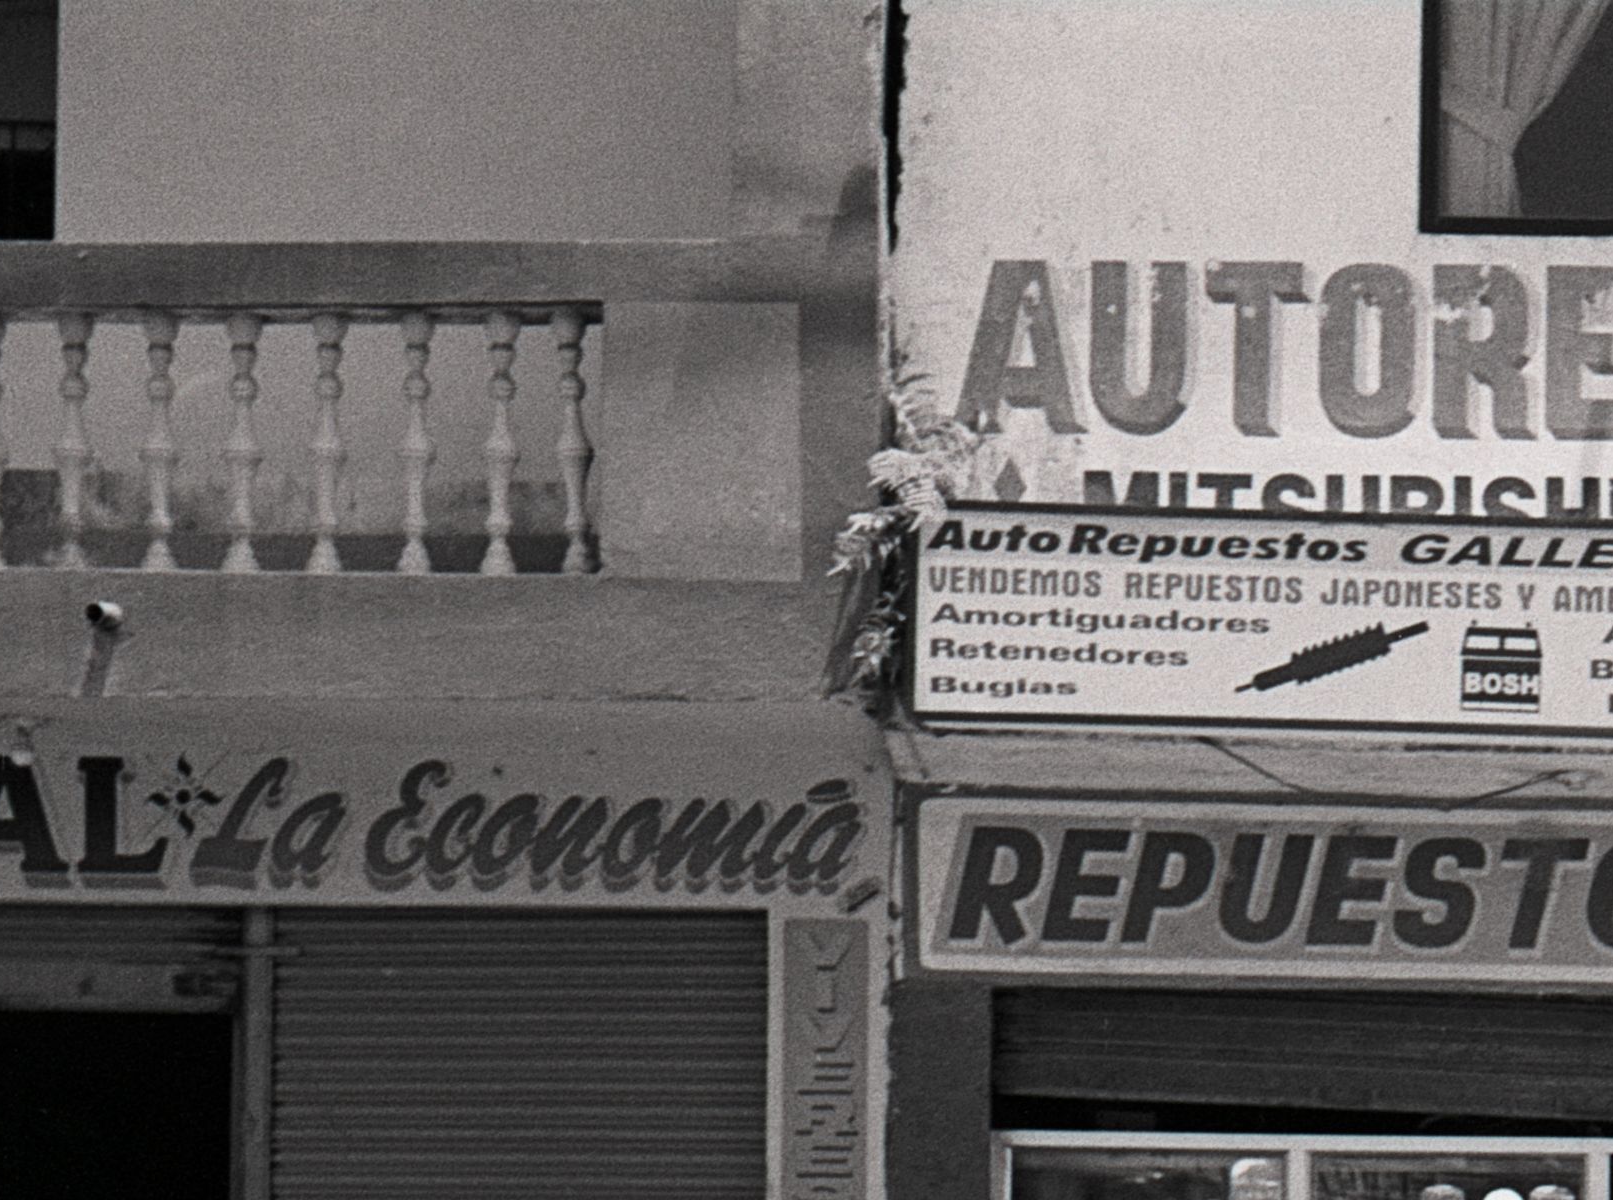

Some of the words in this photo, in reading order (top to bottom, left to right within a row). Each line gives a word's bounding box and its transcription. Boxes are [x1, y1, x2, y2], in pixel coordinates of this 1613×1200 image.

[1069, 523, 1368, 564] Repuestos
[929, 565, 1103, 598] VENDEMOS
[1124, 571, 1304, 605] REPUESTOS
[1320, 577, 1502, 611] JAPONESES
[1517, 582, 1536, 612] Y
[932, 604, 1272, 634] Amortiguadores
[930, 637, 1190, 667] Retenedores
[1464, 673, 1538, 695] BOSH
[190, 756, 350, 889] La
